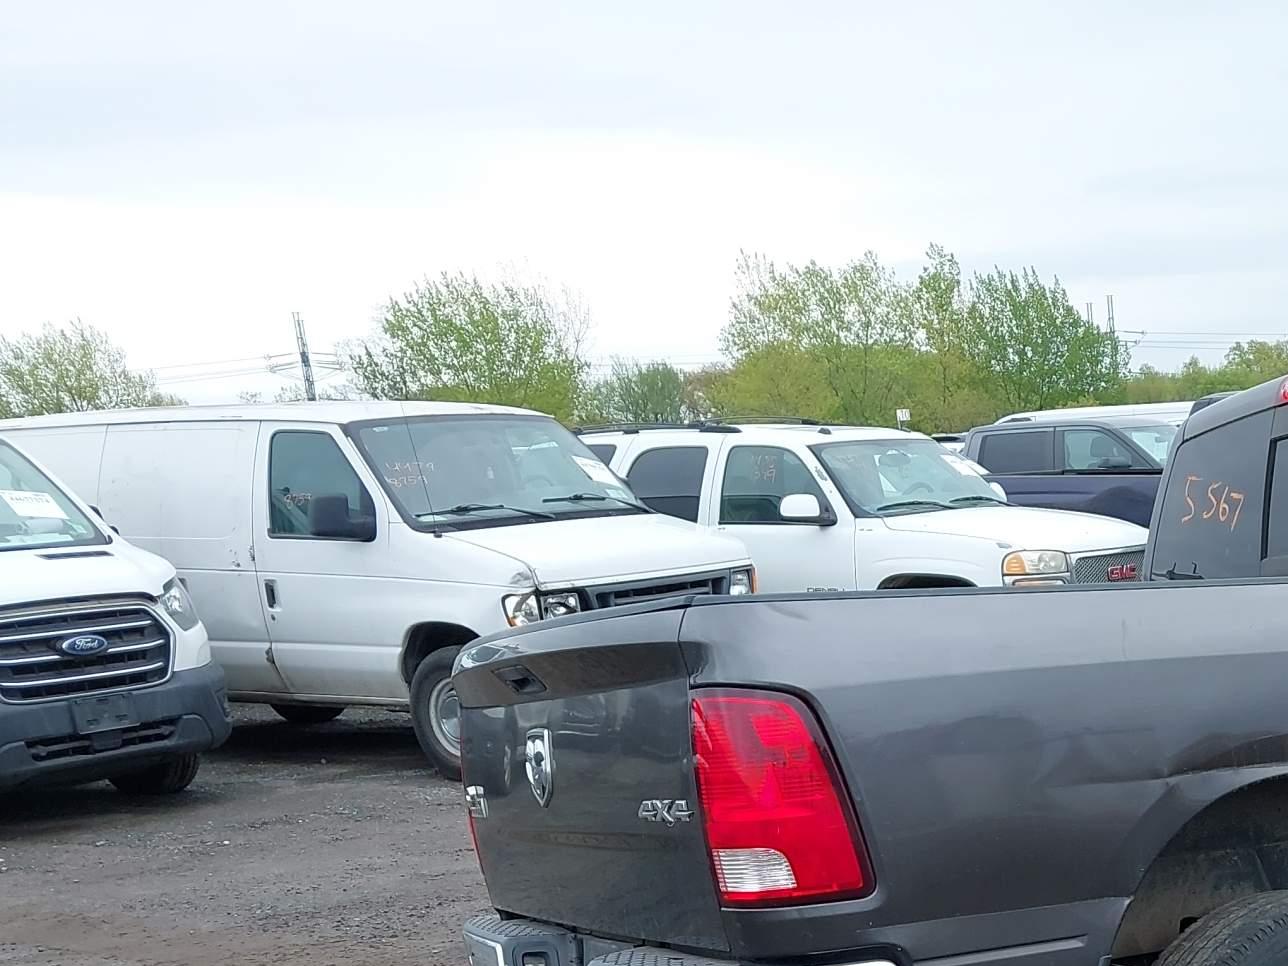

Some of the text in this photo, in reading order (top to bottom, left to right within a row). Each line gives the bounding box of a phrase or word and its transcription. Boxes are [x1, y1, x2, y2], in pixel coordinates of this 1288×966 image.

[1181, 475, 1245, 532] 5567
[1107, 564, 1137, 581] GMC
[74, 638, 99, 650] Ford
[637, 799, 695, 824] 4X4
